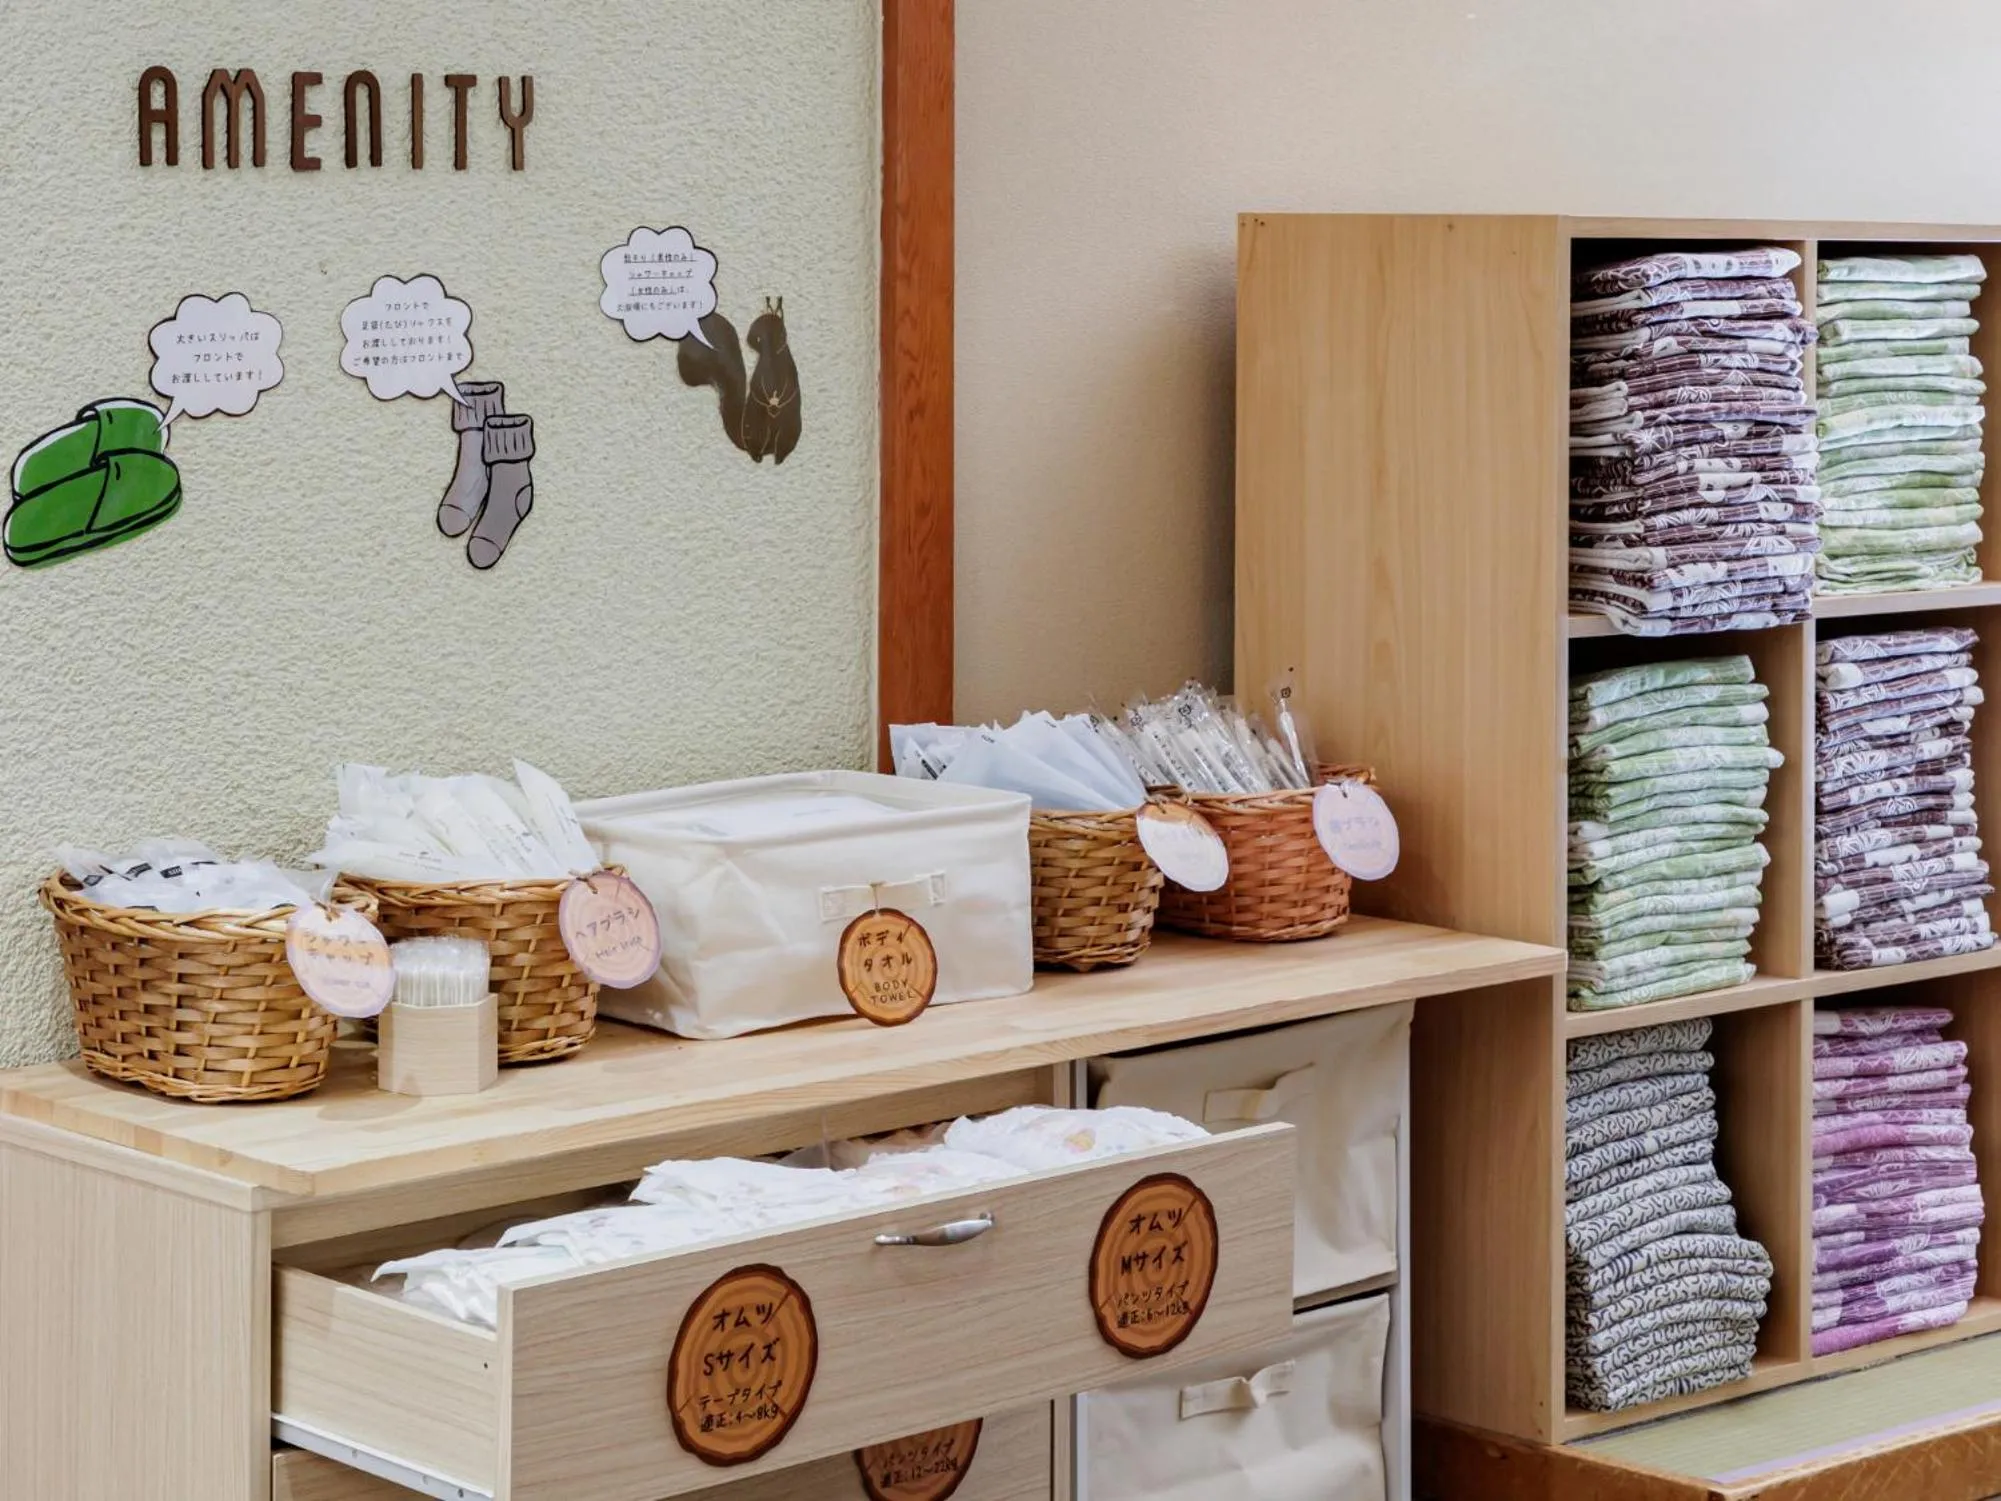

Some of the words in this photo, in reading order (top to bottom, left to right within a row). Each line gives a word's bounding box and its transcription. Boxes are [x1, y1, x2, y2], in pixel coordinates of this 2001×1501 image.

[137, 65, 535, 173] AMENITY
[385, 301, 430, 312] フロントで
[175, 331, 260, 345] 大きいスリッパは
[193, 351, 244, 363] フロントで
[857, 929, 904, 947] ボディ
[863, 951, 913, 973] タオル
[870, 991, 917, 1006] TOWEL
[873, 979, 909, 993] BODY
[1128, 1207, 1183, 1236] オムツ
[1120, 1240, 1189, 1277] Mサイズ
[1117, 1280, 1190, 1308] パンツタイプ
[712, 1301, 774, 1333] オムツ
[703, 1336, 781, 1377] Sサイズ
[699, 1379, 784, 1412] テープタイプ
